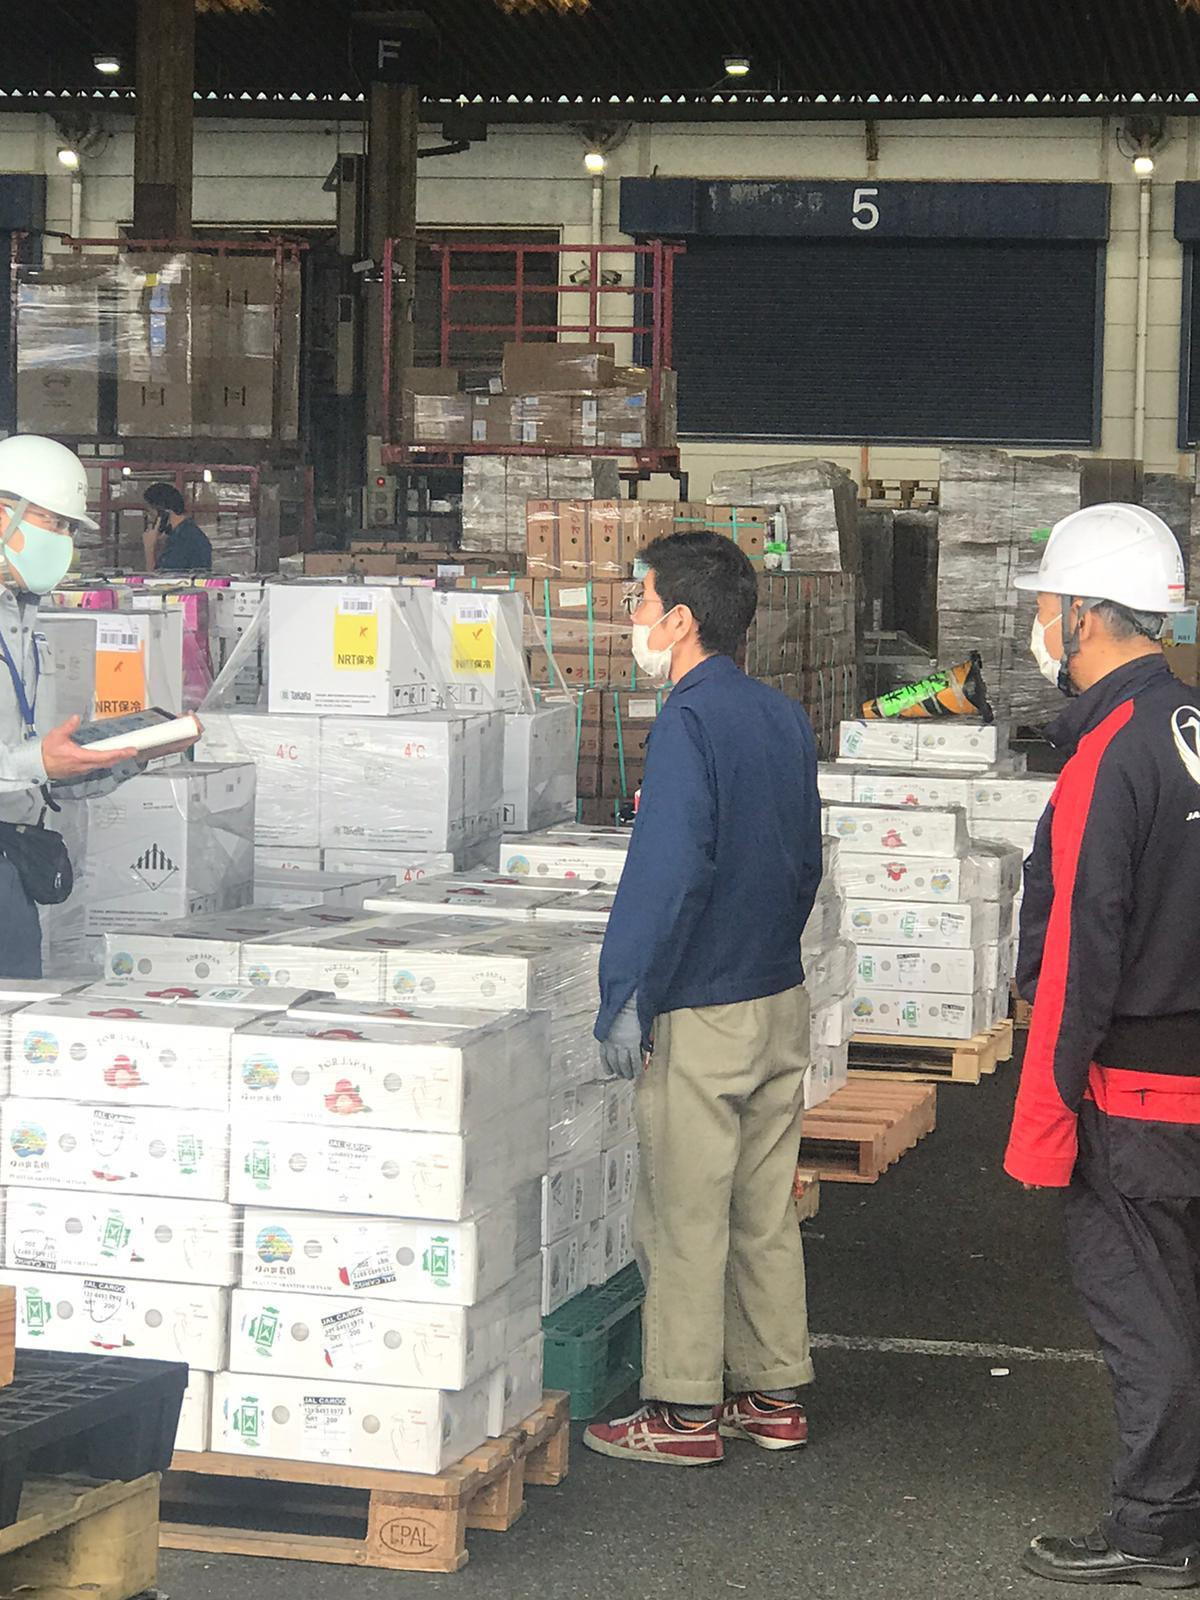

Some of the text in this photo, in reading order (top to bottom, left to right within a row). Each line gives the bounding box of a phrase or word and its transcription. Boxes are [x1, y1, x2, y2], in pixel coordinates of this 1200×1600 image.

[378, 40, 402, 69] F
[851, 187, 881, 231] 5
[337, 653, 374, 666] NRT保冷
[95, 699, 142, 713] NRT保冷
[1186, 811, 1200, 821] JA
[304, 1397, 346, 1406] JAL CARGO
[390, 1525, 432, 1547] EPAL
